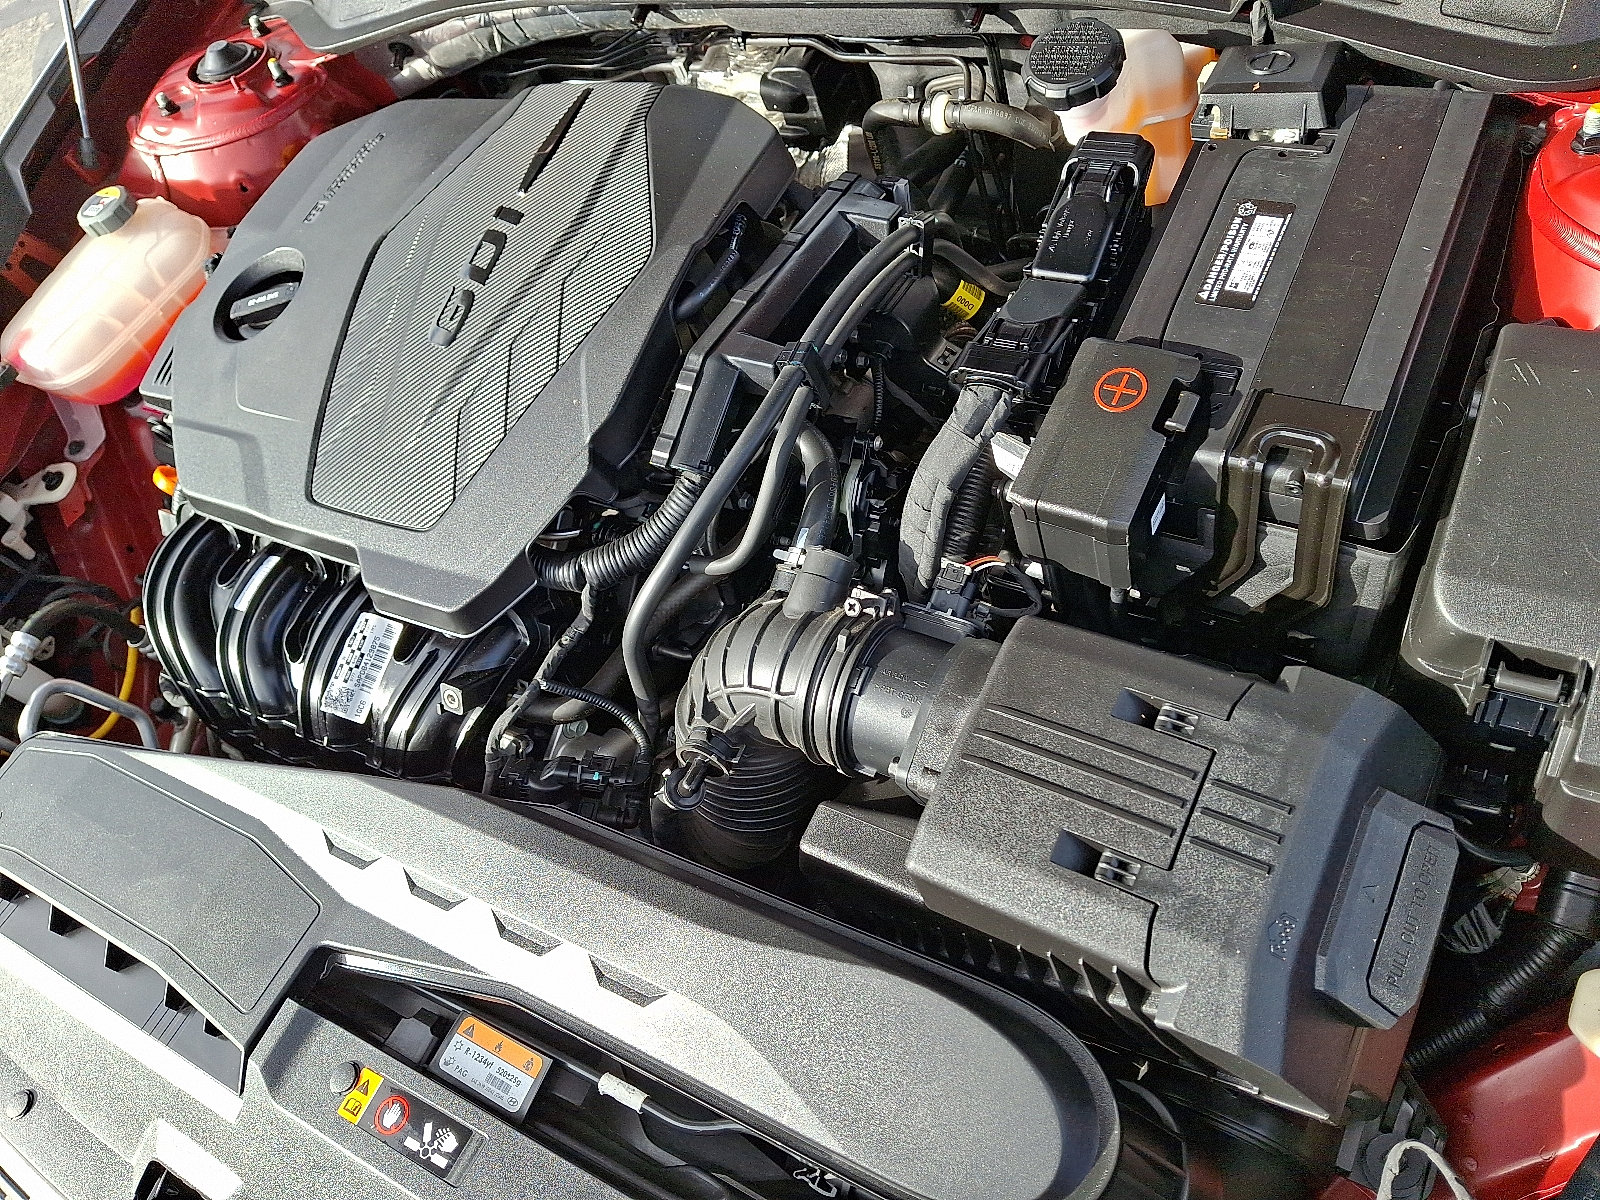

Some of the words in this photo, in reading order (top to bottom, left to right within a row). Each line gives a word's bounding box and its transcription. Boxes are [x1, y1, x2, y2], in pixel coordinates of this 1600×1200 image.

[1418, 844, 1441, 887] OPEN
[1411, 887, 1428, 910] TO
[1401, 911, 1418, 947] OUT
[1386, 950, 1411, 990] PULL
[453, 1064, 469, 1078] PAG
